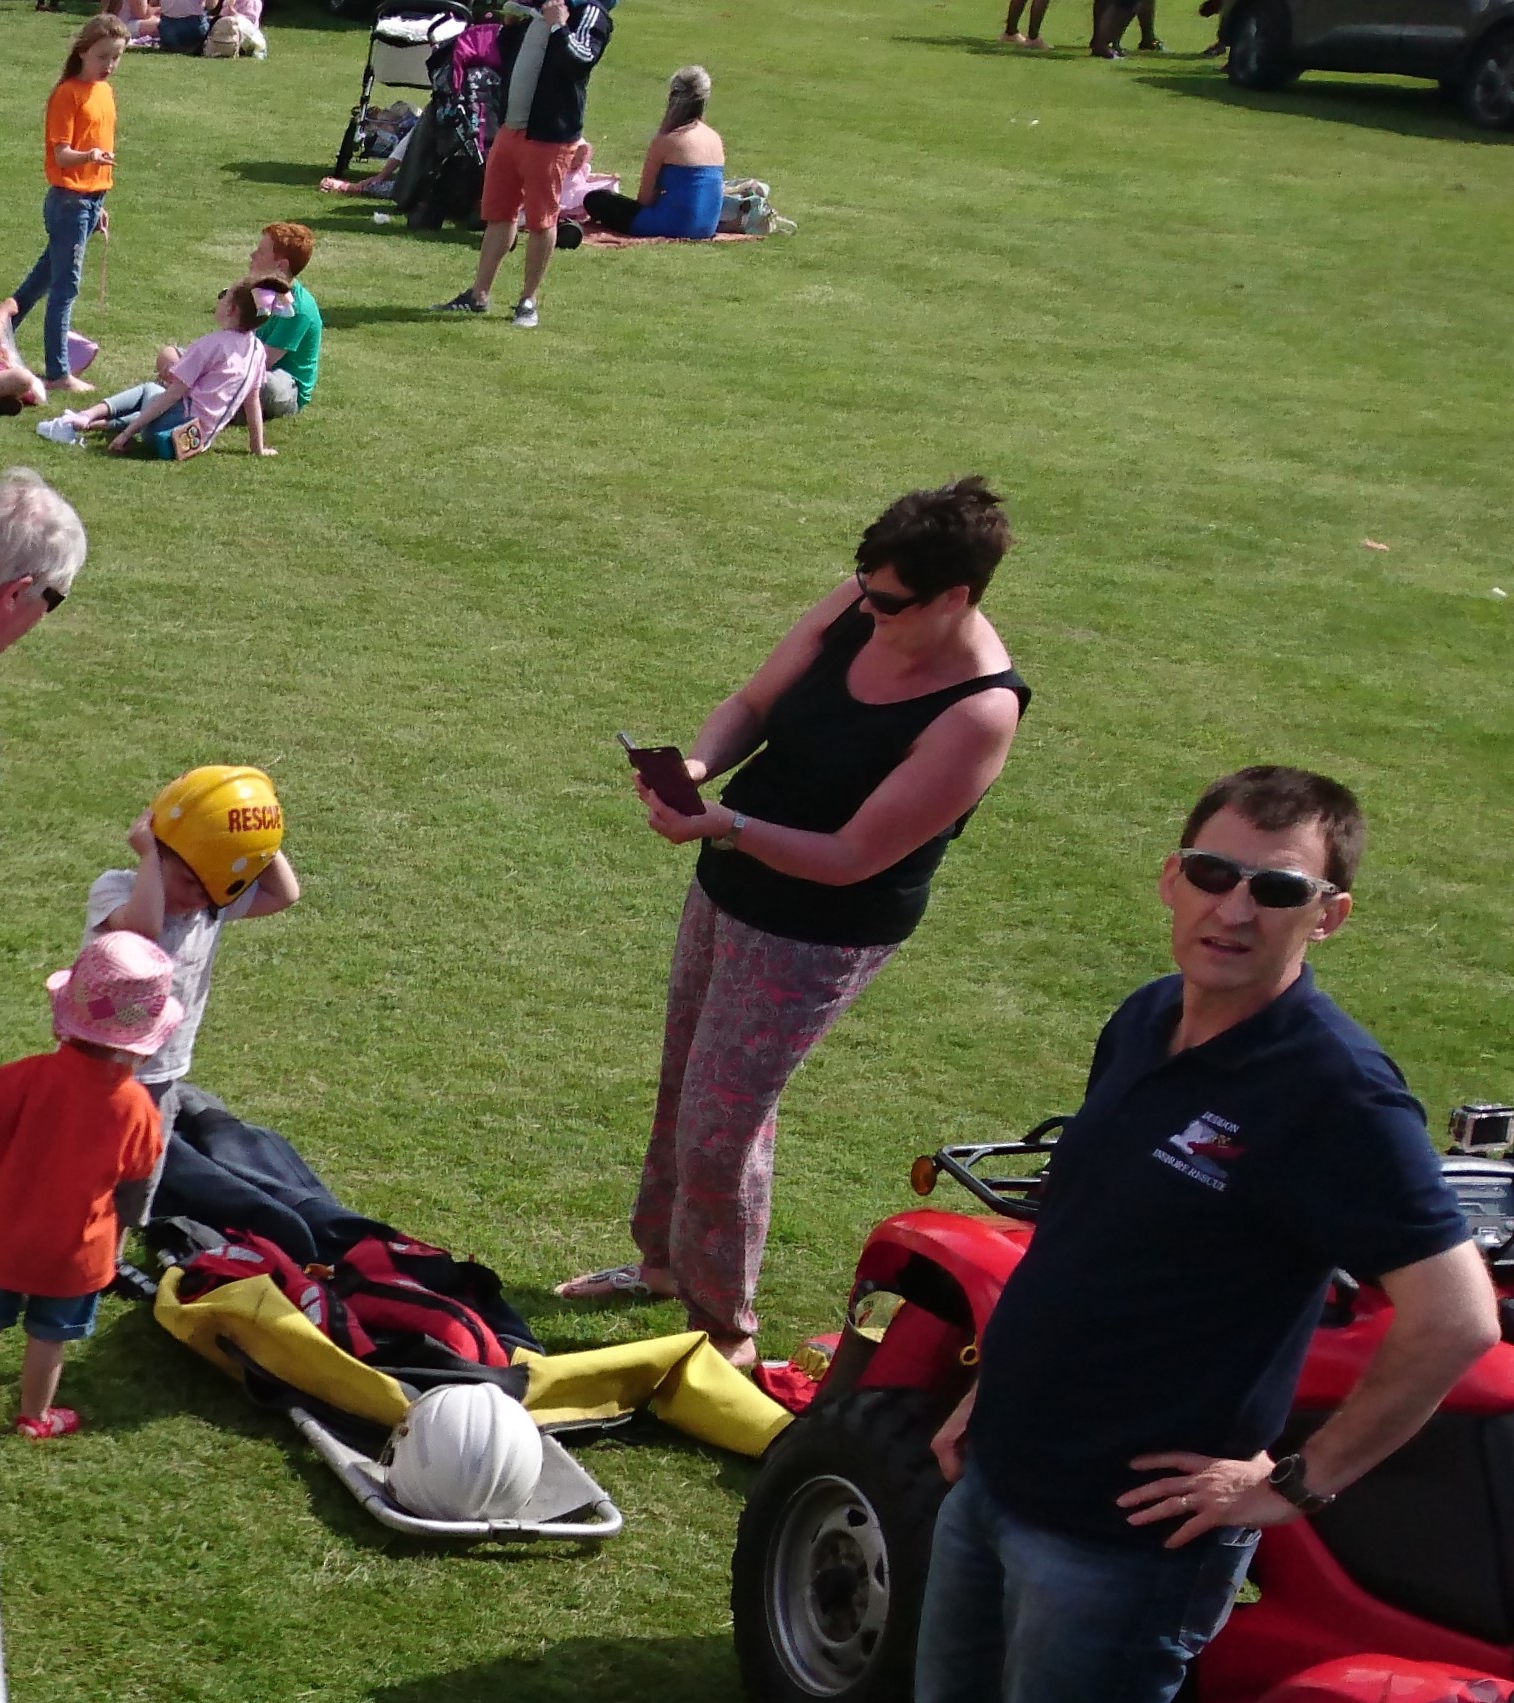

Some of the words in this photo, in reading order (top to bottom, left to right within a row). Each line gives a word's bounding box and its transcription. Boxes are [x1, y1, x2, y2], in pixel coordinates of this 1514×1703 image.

[1201, 1111, 1240, 1133] DUDDON
[1152, 1148, 1190, 1173] INSHORE
[1188, 1168, 1227, 1192] RESCUE
